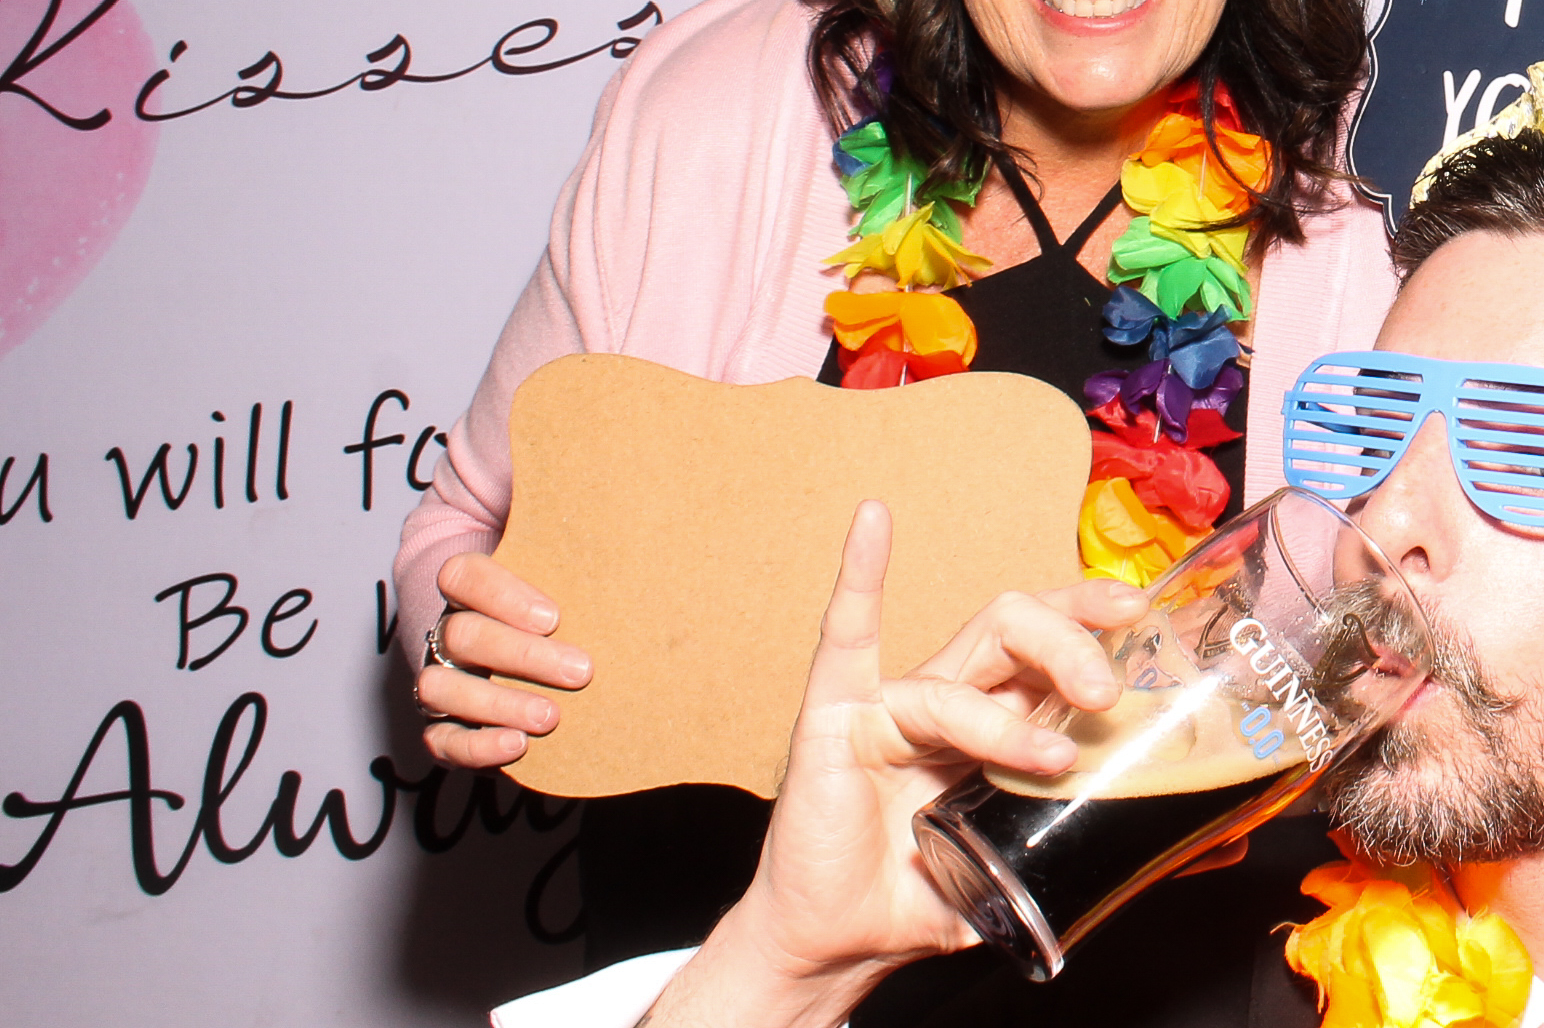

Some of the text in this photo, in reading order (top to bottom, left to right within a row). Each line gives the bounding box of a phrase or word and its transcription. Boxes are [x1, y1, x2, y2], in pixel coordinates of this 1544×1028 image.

[105, 401, 292, 520] will
[155, 572, 318, 670] Be
[1230, 617, 1334, 773] GUINNESS
